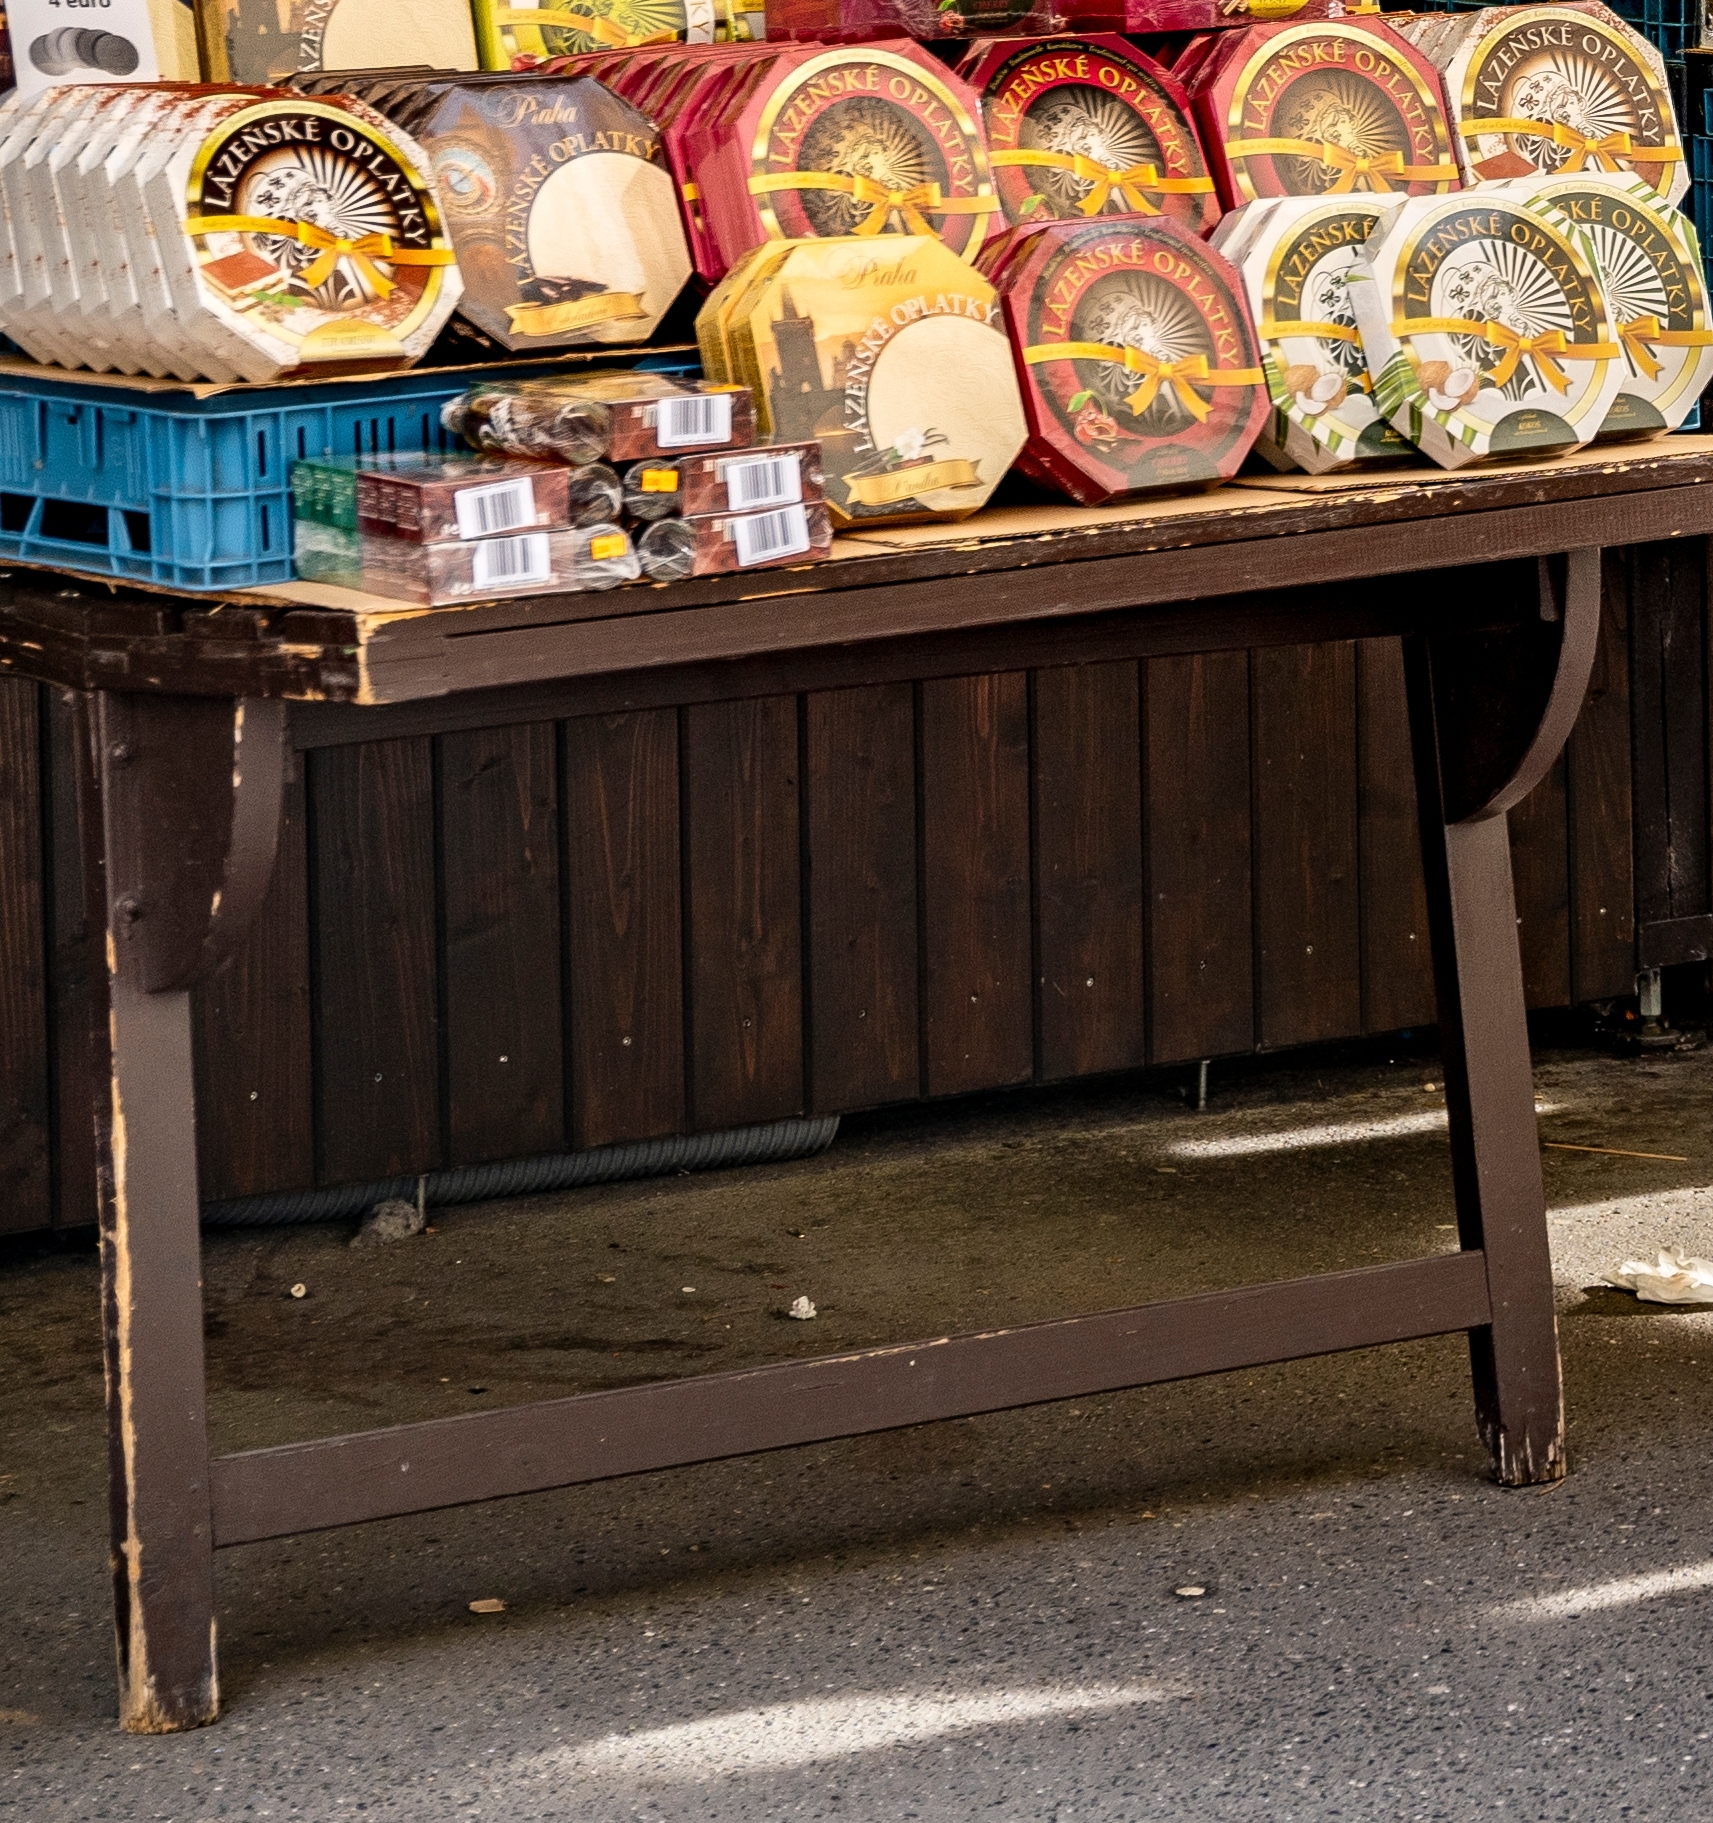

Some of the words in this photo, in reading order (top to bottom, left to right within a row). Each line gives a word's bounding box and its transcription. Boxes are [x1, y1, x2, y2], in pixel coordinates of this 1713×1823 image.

[769, 64, 881, 165] LÁZEŇSKÉ
[888, 76, 975, 194] OPLATKY
[991, 54, 1091, 143] LÁZEŇSKÉ
[1098, 66, 1189, 175] OPLATKY
[1244, 38, 1346, 131] LÁZEŇSKÉ
[1354, 50, 1435, 162] OPLATKY
[1476, 22, 1574, 111] LÁZEŇSKÉ
[1581, 34, 1661, 144] OPLATKY
[204, 117, 323, 208] LÁZEŇSKÉ
[329, 129, 428, 246] OPLATKY
[549, 130, 662, 163] OPLATKY
[889, 293, 1000, 325] OPLATKY
[1042, 239, 1146, 336] LÁZEŇSKÉ
[1152, 251, 1240, 366] OPLATKY
[1407, 212, 1502, 304] LÁZEŇSKÉ
[1511, 223, 1593, 332] OPLATKY
[1611, 208, 1689, 321] OPLATKY
